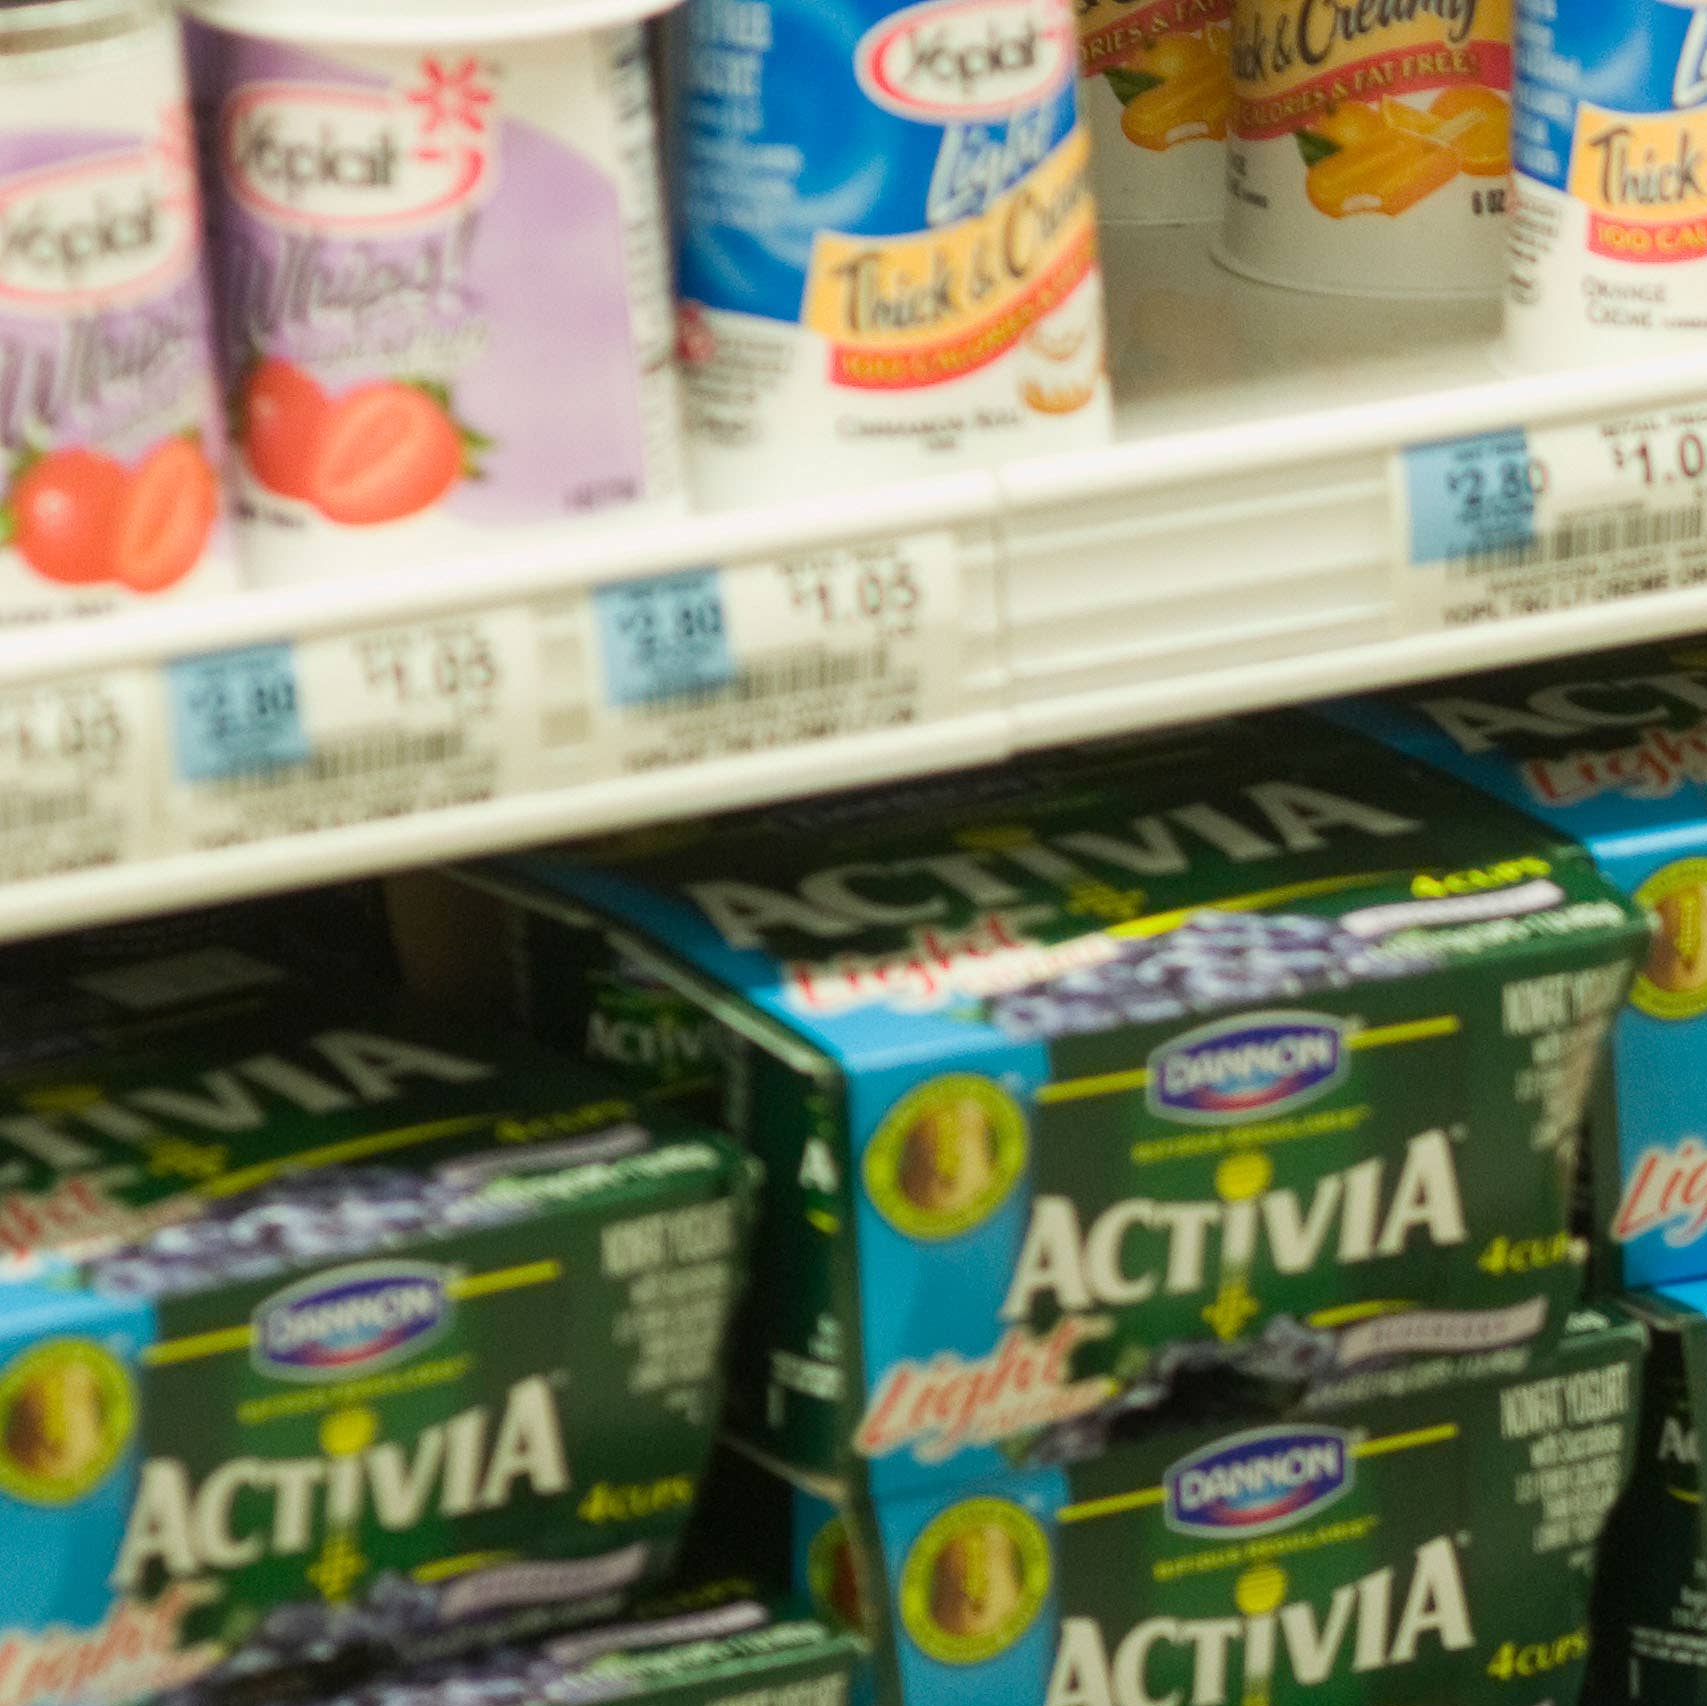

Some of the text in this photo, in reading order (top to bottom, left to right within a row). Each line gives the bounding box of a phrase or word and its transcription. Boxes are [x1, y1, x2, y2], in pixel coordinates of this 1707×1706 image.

[1590, 123, 1702, 205] Thick
[1003, 1128, 1468, 1322] ACTIVIA
[111, 1374, 571, 1592] ACTIVIA
